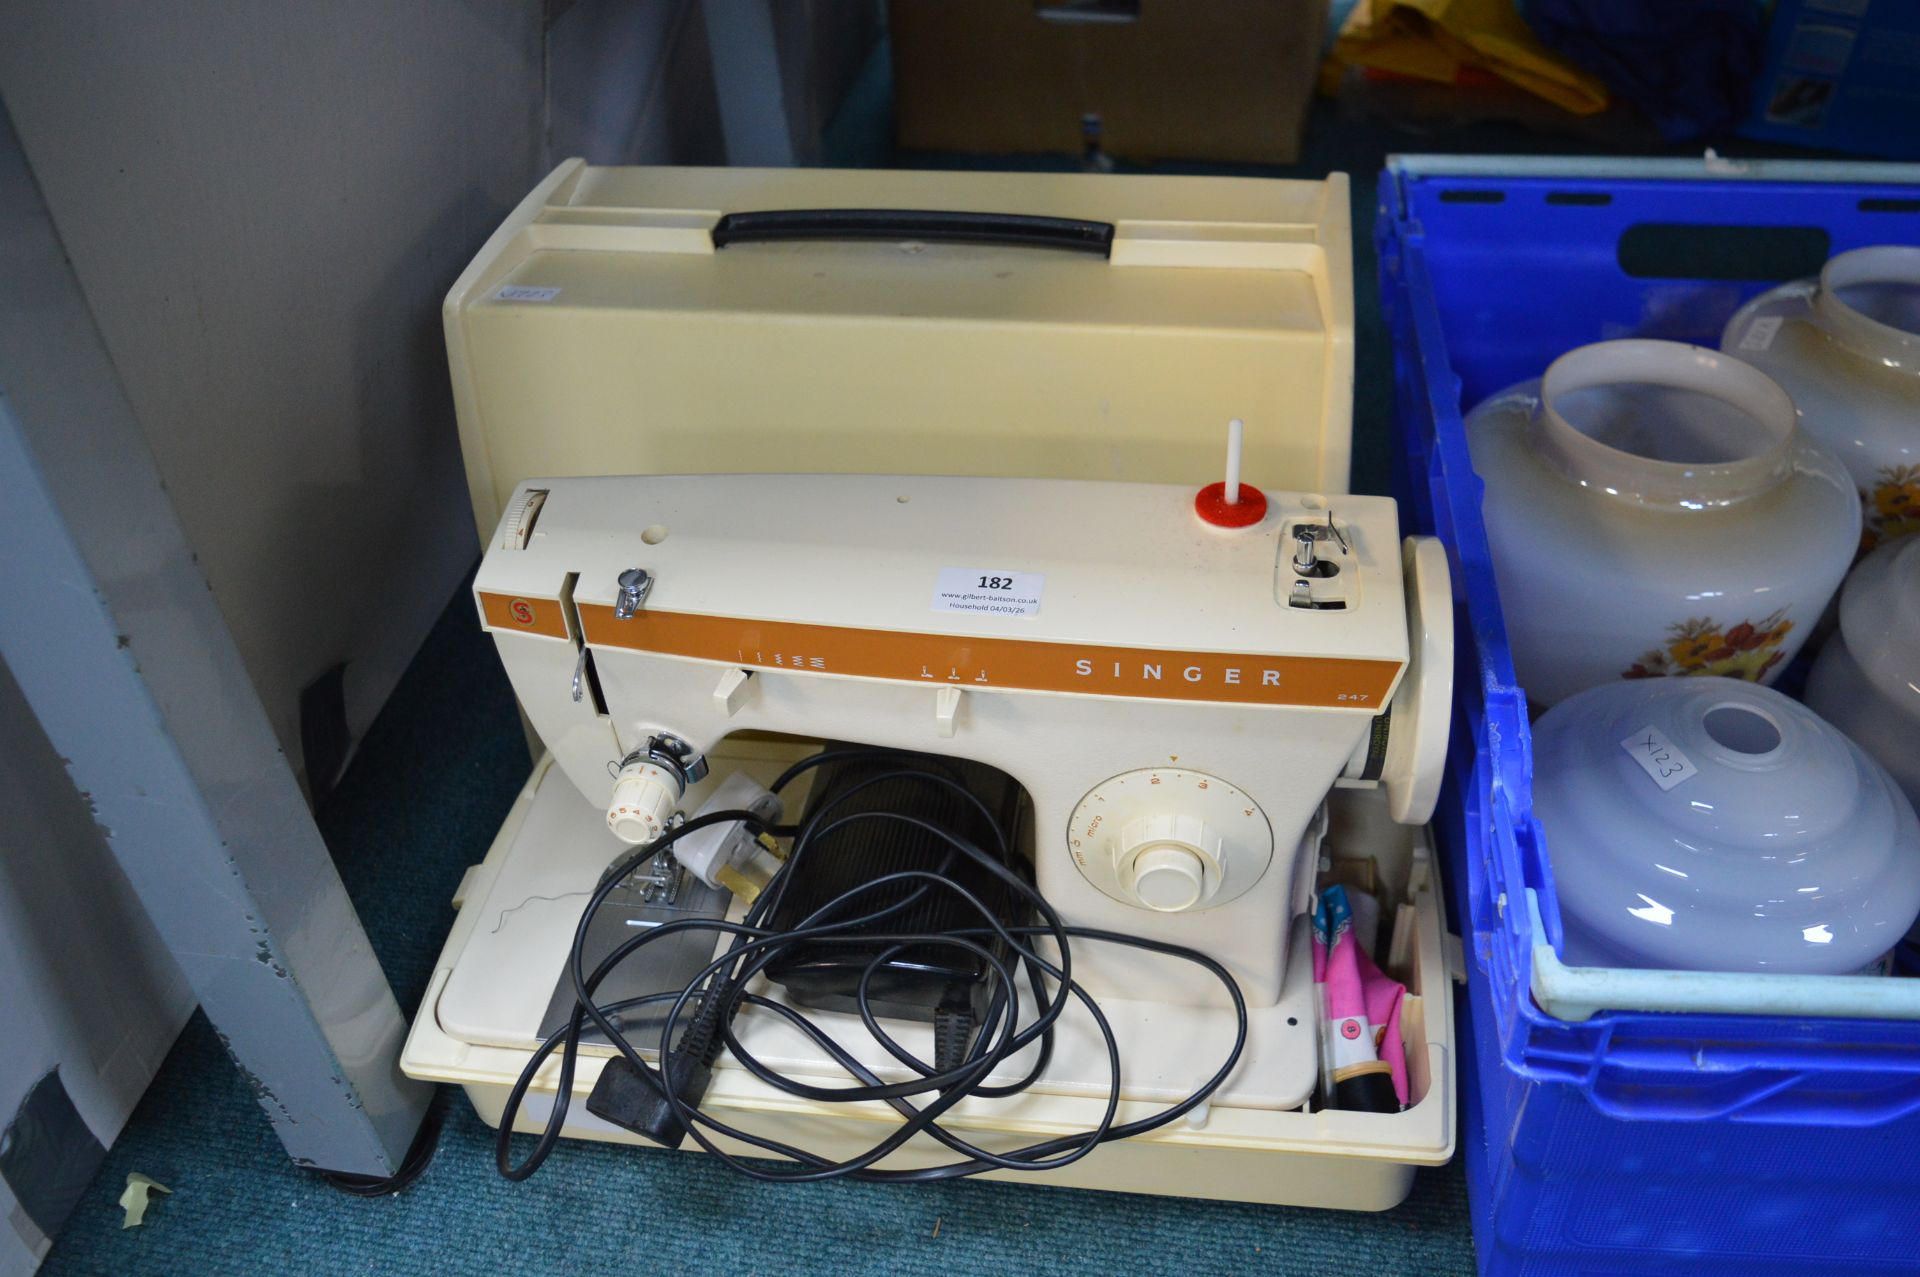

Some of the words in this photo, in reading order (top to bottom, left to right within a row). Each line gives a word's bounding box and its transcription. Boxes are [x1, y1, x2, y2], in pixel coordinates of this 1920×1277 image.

[978, 575, 1013, 590] 182
[941, 592, 1038, 604] www.gilbert-baitson.co.uk
[949, 602, 989, 611] Household
[990, 605, 1025, 614] 04/03/26
[1075, 659, 1281, 686] SINGER
[1337, 693, 1368, 701] 247
[1087, 815, 1103, 838] micro
